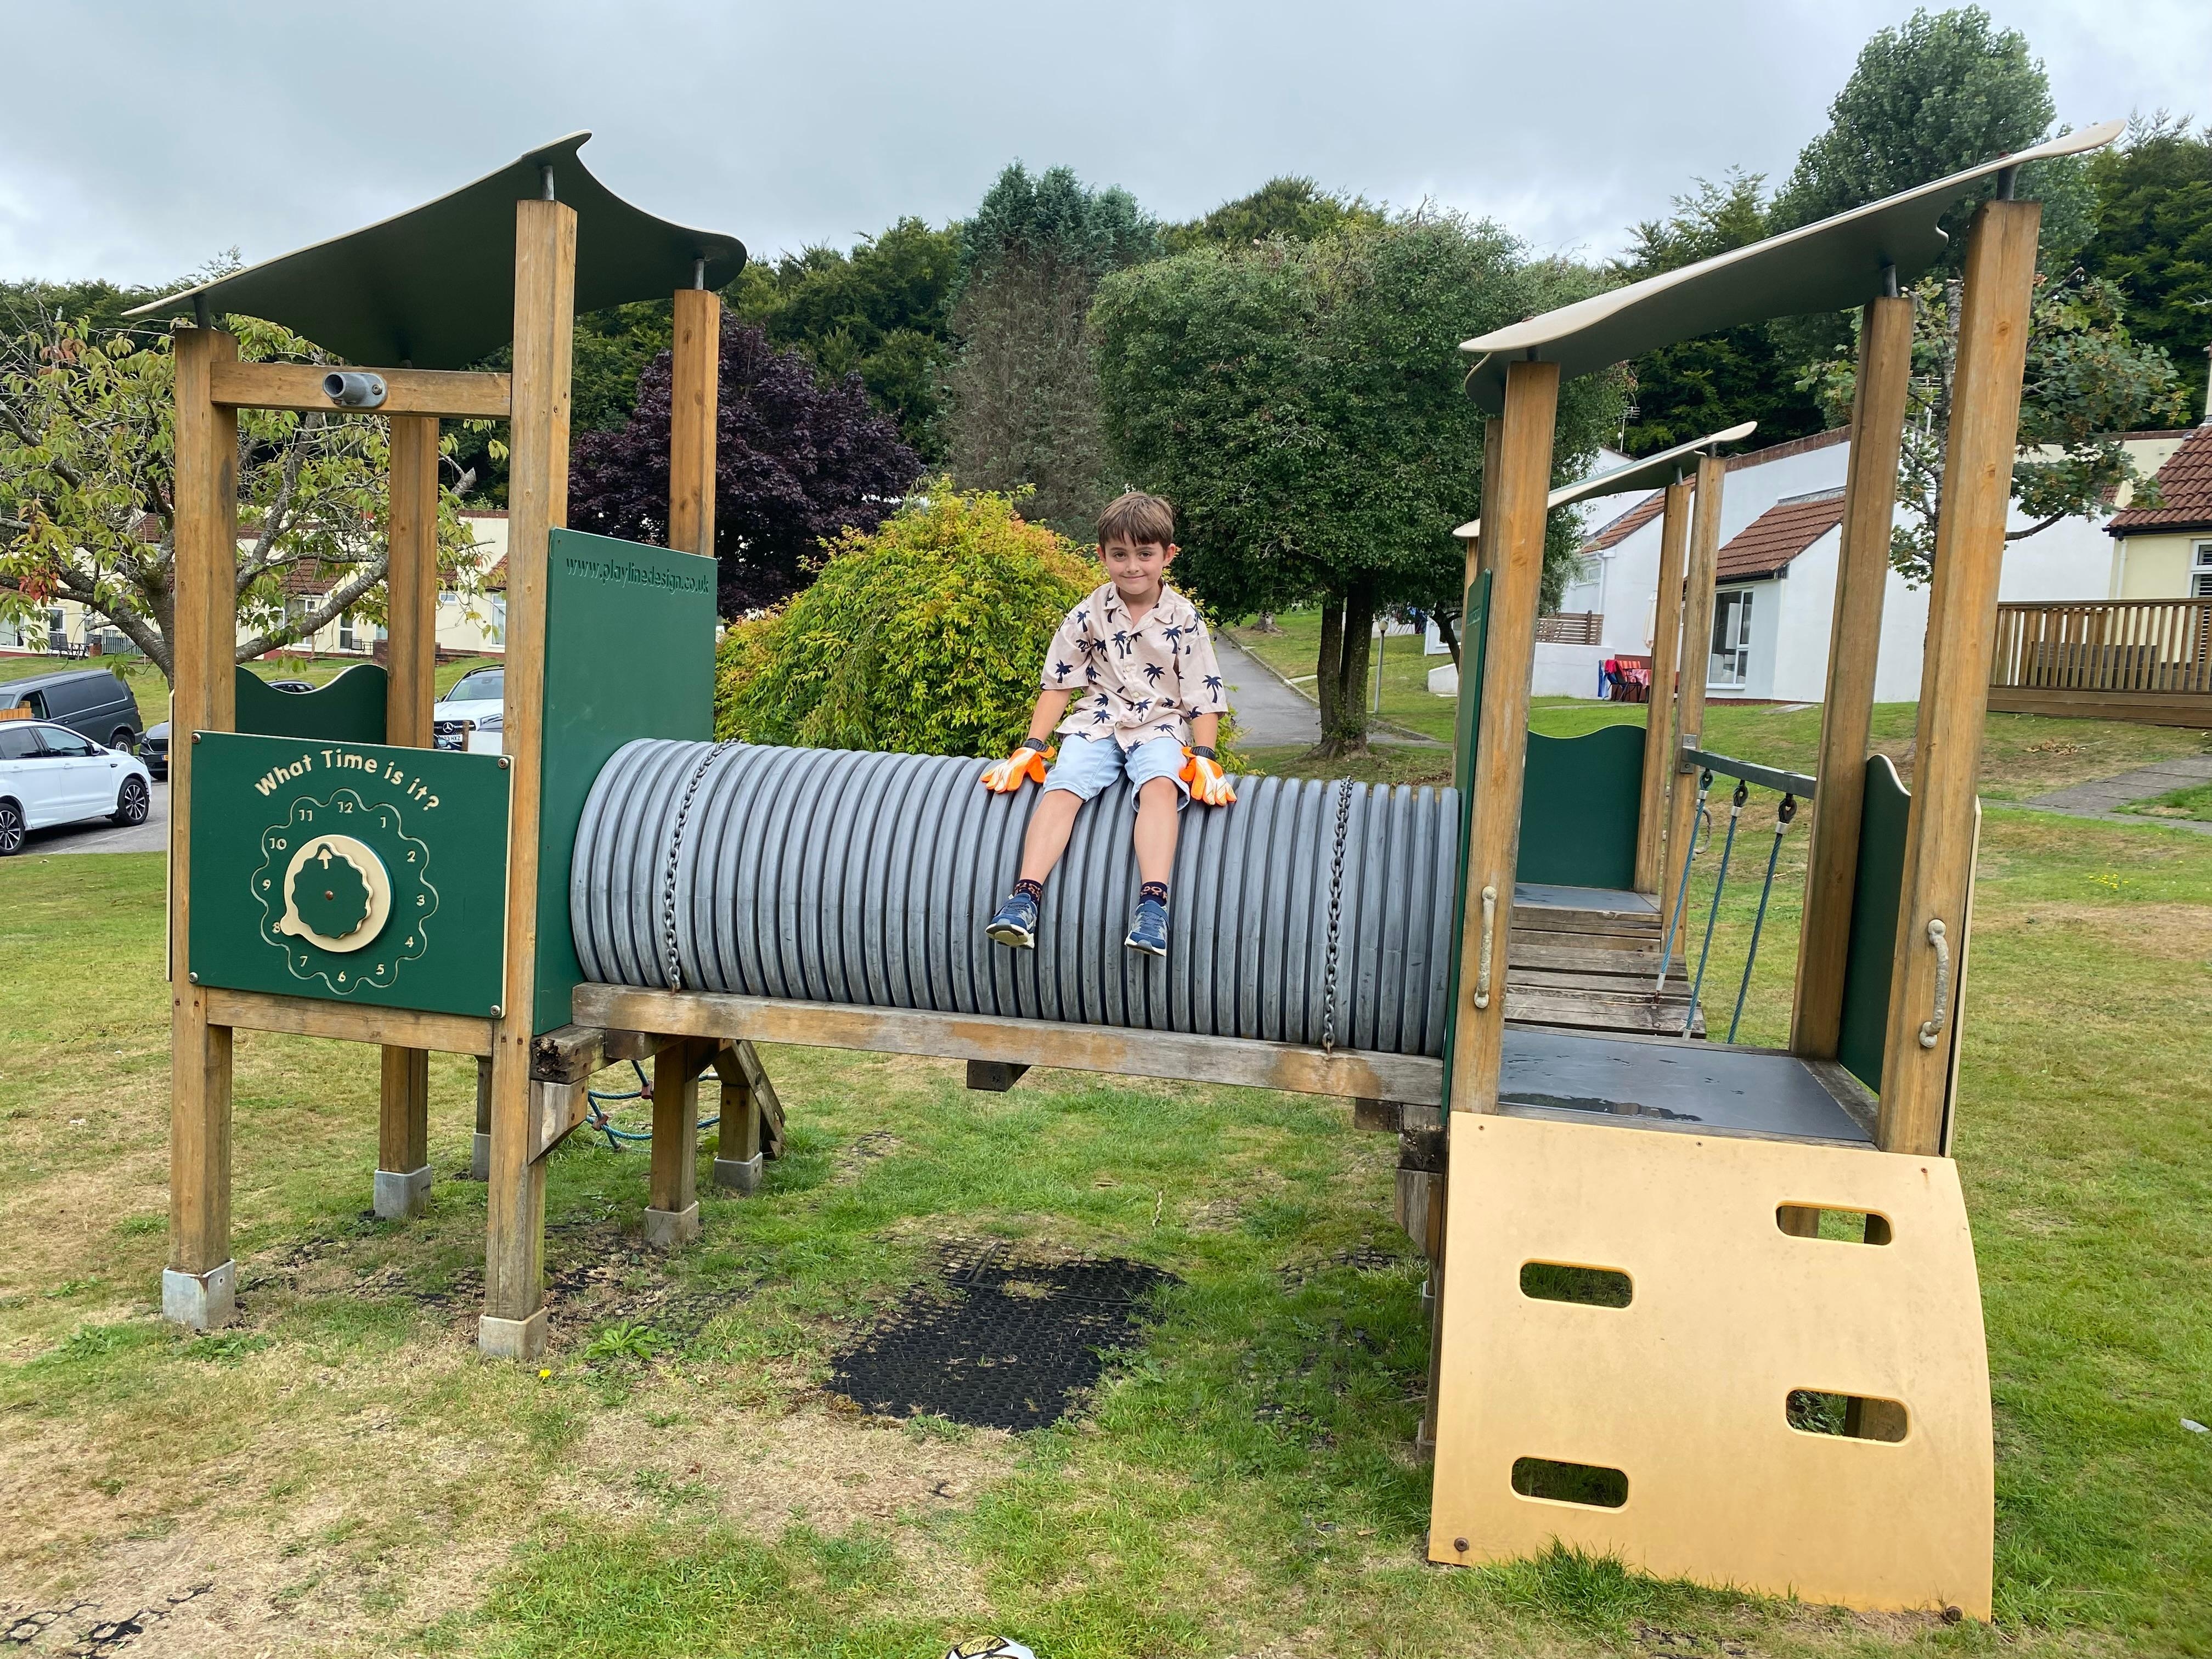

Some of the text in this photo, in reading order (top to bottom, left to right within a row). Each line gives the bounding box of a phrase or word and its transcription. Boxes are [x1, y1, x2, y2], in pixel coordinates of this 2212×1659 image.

[566, 558, 709, 595] www.playlinedesign.co.uk
[254, 748, 439, 811] What Time is it?
[337, 801, 353, 814] 12
[298, 809, 313, 822] 11
[380, 816, 386, 828] 1
[268, 838, 287, 850] 10
[407, 850, 416, 863] 2
[262, 879, 272, 891] 9
[416, 894, 425, 907] 3
[272, 922, 281, 934] 8
[404, 936, 414, 948] 4
[299, 955, 308, 967] 7
[375, 964, 385, 975] 5
[337, 971, 346, 983] 6
